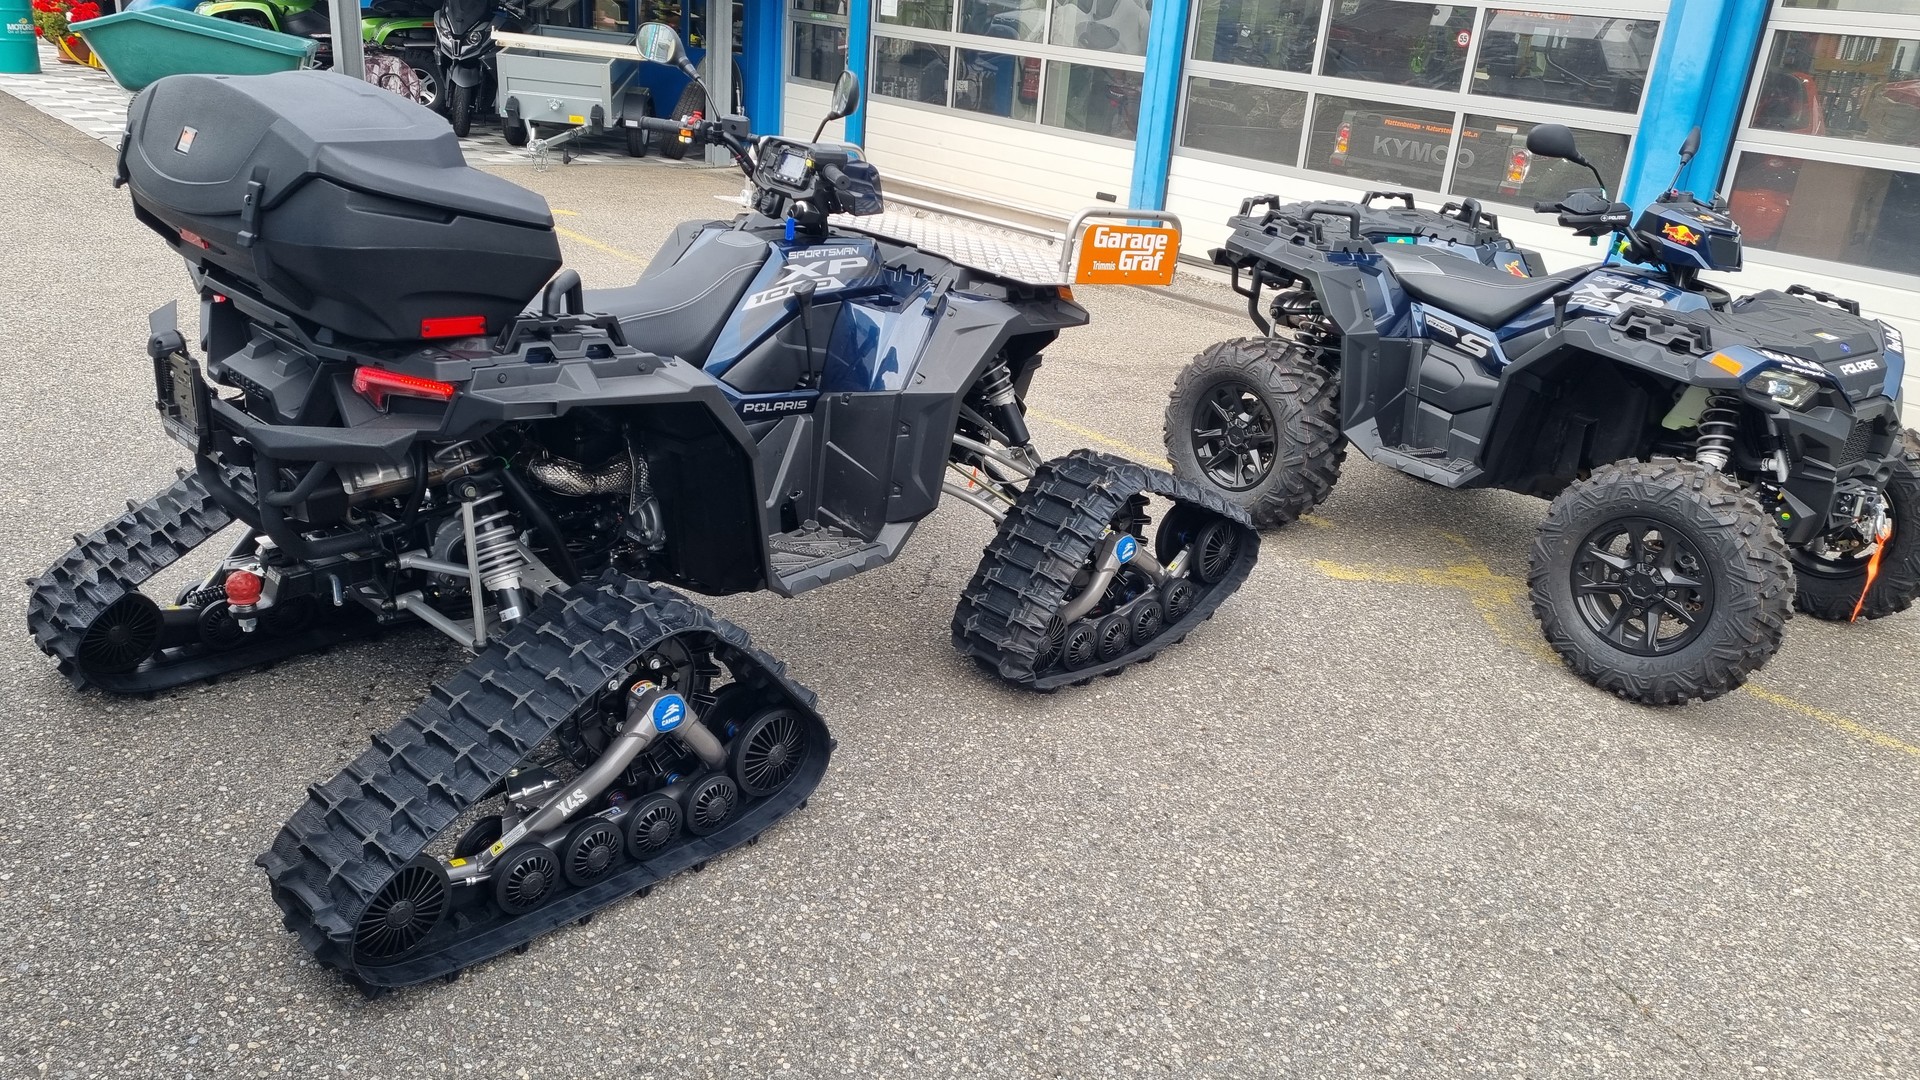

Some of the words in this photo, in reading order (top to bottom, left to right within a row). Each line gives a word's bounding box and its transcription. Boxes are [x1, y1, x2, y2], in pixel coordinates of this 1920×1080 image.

[1459, 34, 1468, 43] 55
[1093, 227, 1168, 255] Garage
[788, 247, 860, 260] SPORTSMAN
[1118, 250, 1165, 271] Graf
[775, 256, 868, 285] XP
[1093, 260, 1116, 271] Trimmis
[1574, 283, 1666, 308] XP
[1592, 275, 1667, 298] SPORTSMAN
[1455, 333, 1494, 359] S
[1839, 358, 1879, 376] POLARIS
[743, 400, 808, 413] POLARIS
[555, 788, 588, 817] X4S
